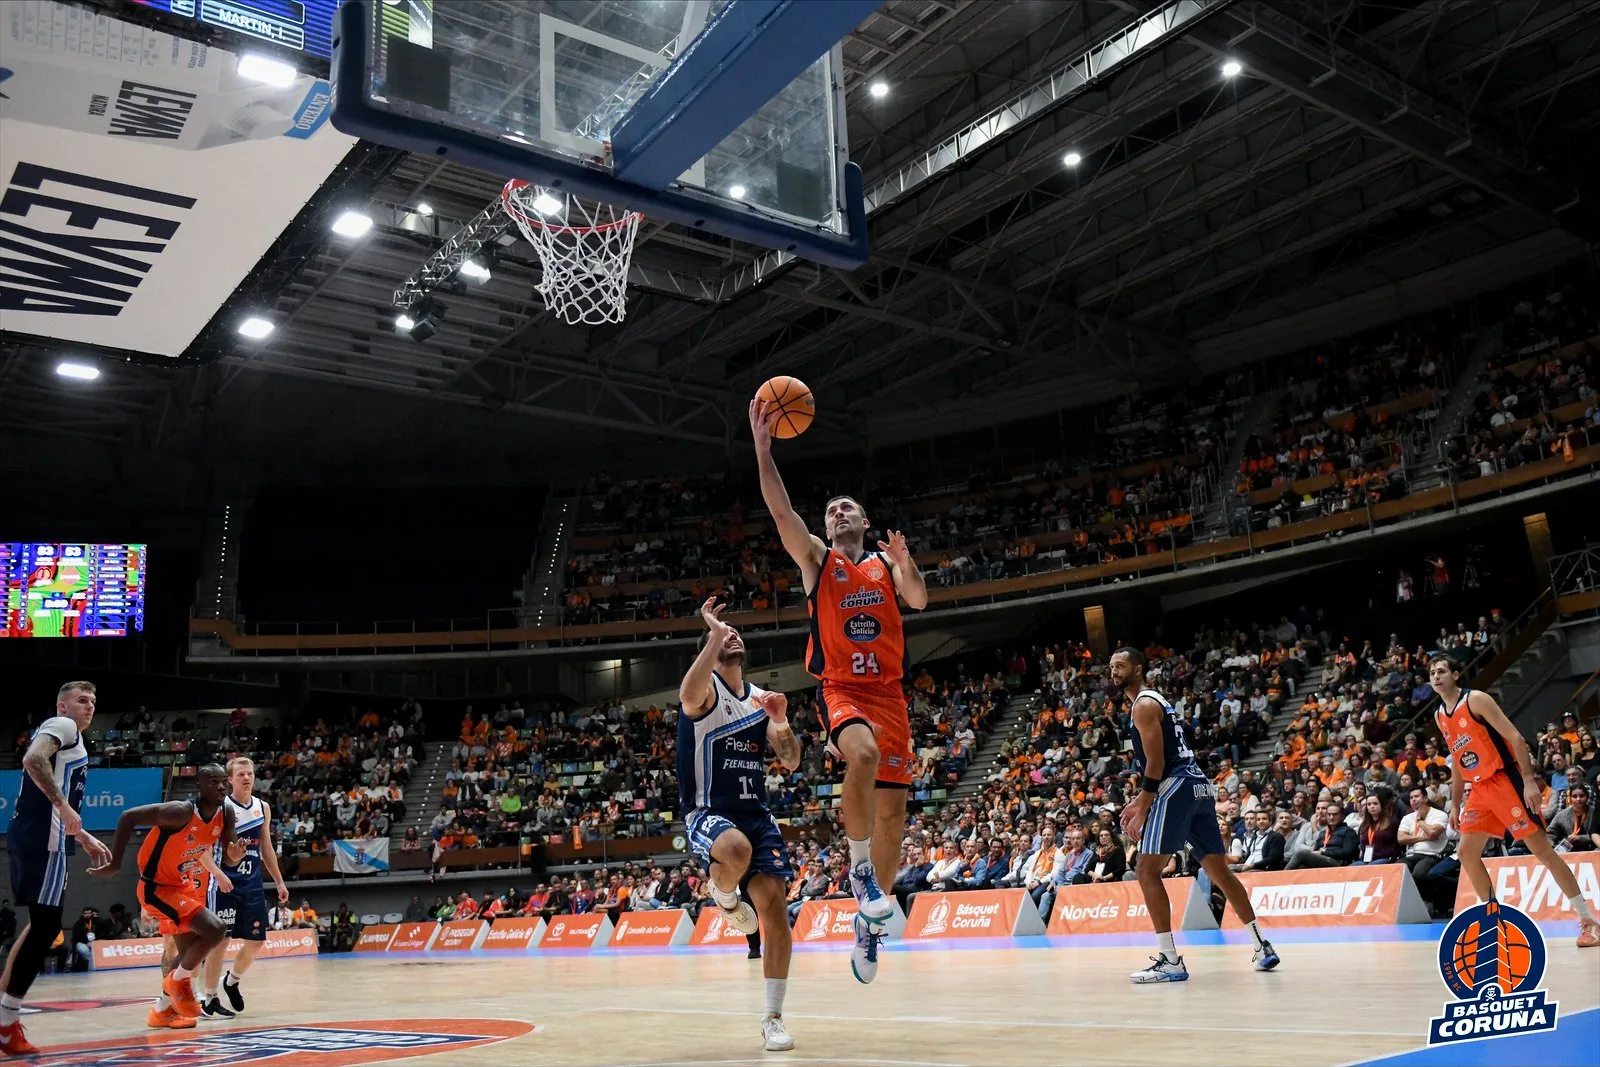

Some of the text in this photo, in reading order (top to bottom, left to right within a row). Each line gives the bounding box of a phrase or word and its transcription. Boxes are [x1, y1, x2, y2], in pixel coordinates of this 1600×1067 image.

[220, 9, 275, 39] MARTIN,
[852, 652, 879, 674] 24
[1477, 862, 1600, 914] EYMA
[956, 903, 999, 917] Básquet
[1060, 900, 1120, 920] Nordés
[1256, 892, 1335, 911] Aluman
[952, 915, 991, 928] Coruña
[264, 939, 300, 949] Galicia
